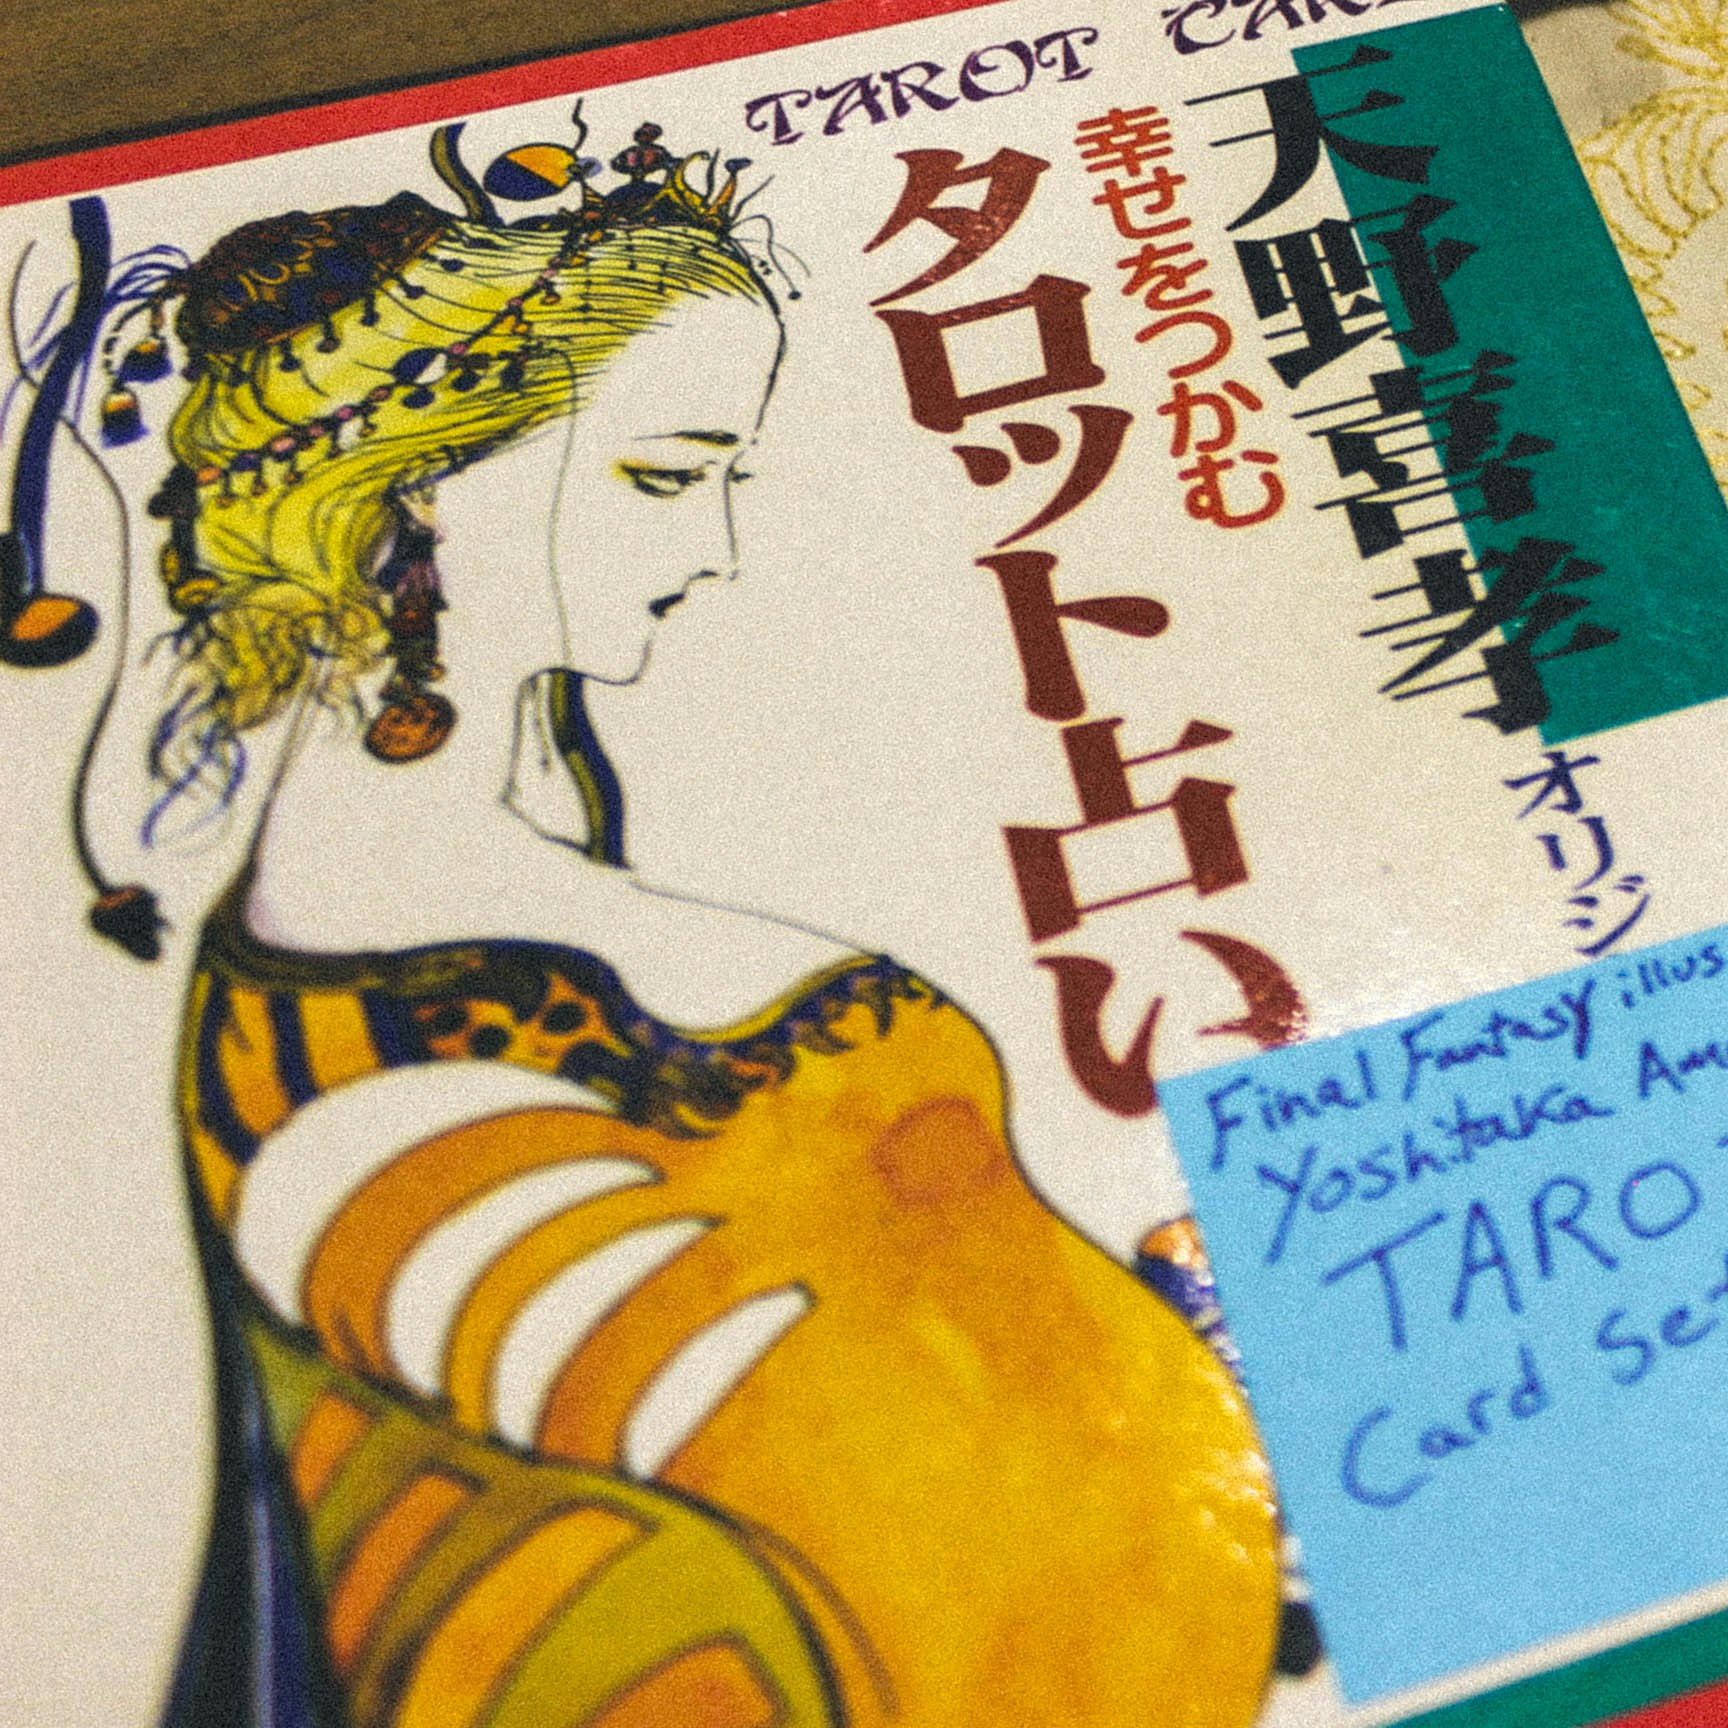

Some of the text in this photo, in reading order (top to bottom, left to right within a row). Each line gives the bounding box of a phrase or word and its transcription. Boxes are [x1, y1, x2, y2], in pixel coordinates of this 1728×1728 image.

[745, 26, 1098, 146] TAROT
[1075, 105, 1286, 530] 幸せをつかむ
[1184, 44, 1621, 736] 天野喜孝
[861, 143, 1310, 1118] タロット占い
[1209, 1050, 1377, 1173] Final
[1402, 977, 1594, 1102] Fantasy
[1341, 1345, 1548, 1508] Card
